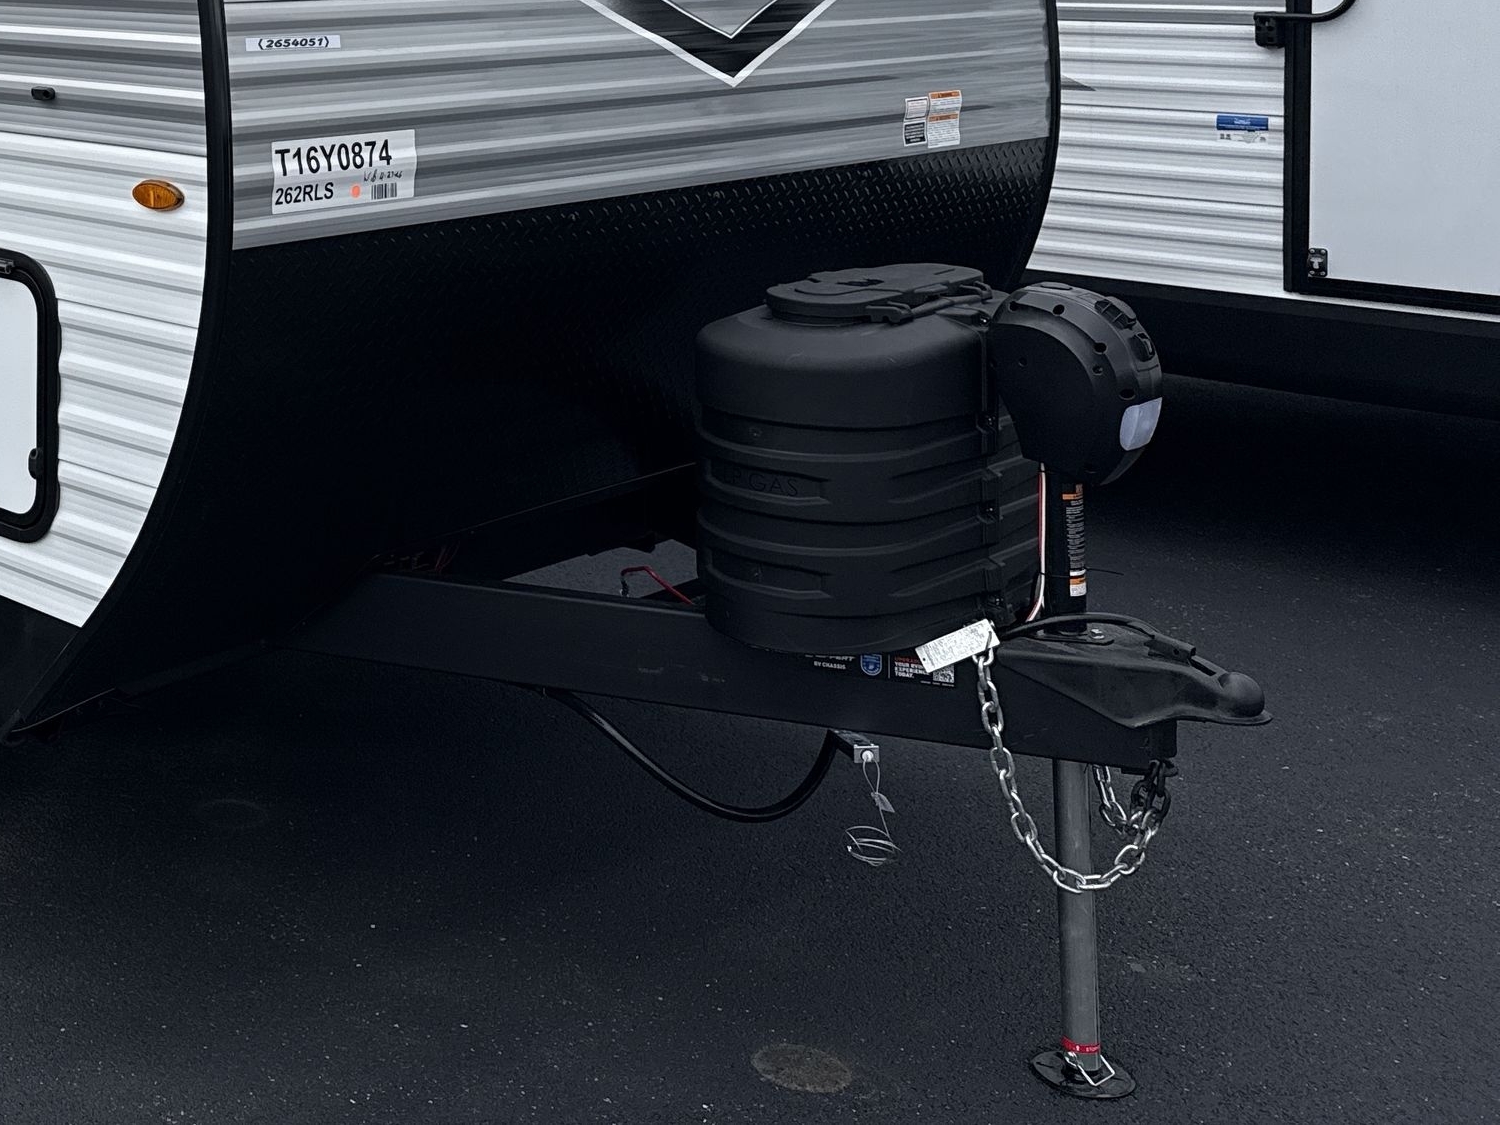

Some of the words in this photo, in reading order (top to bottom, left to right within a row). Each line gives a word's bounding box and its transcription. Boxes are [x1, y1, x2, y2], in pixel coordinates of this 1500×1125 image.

[275, 139, 393, 176] T16Y0874
[275, 182, 334, 205] 262RLS
[749, 473, 798, 497] GAS
